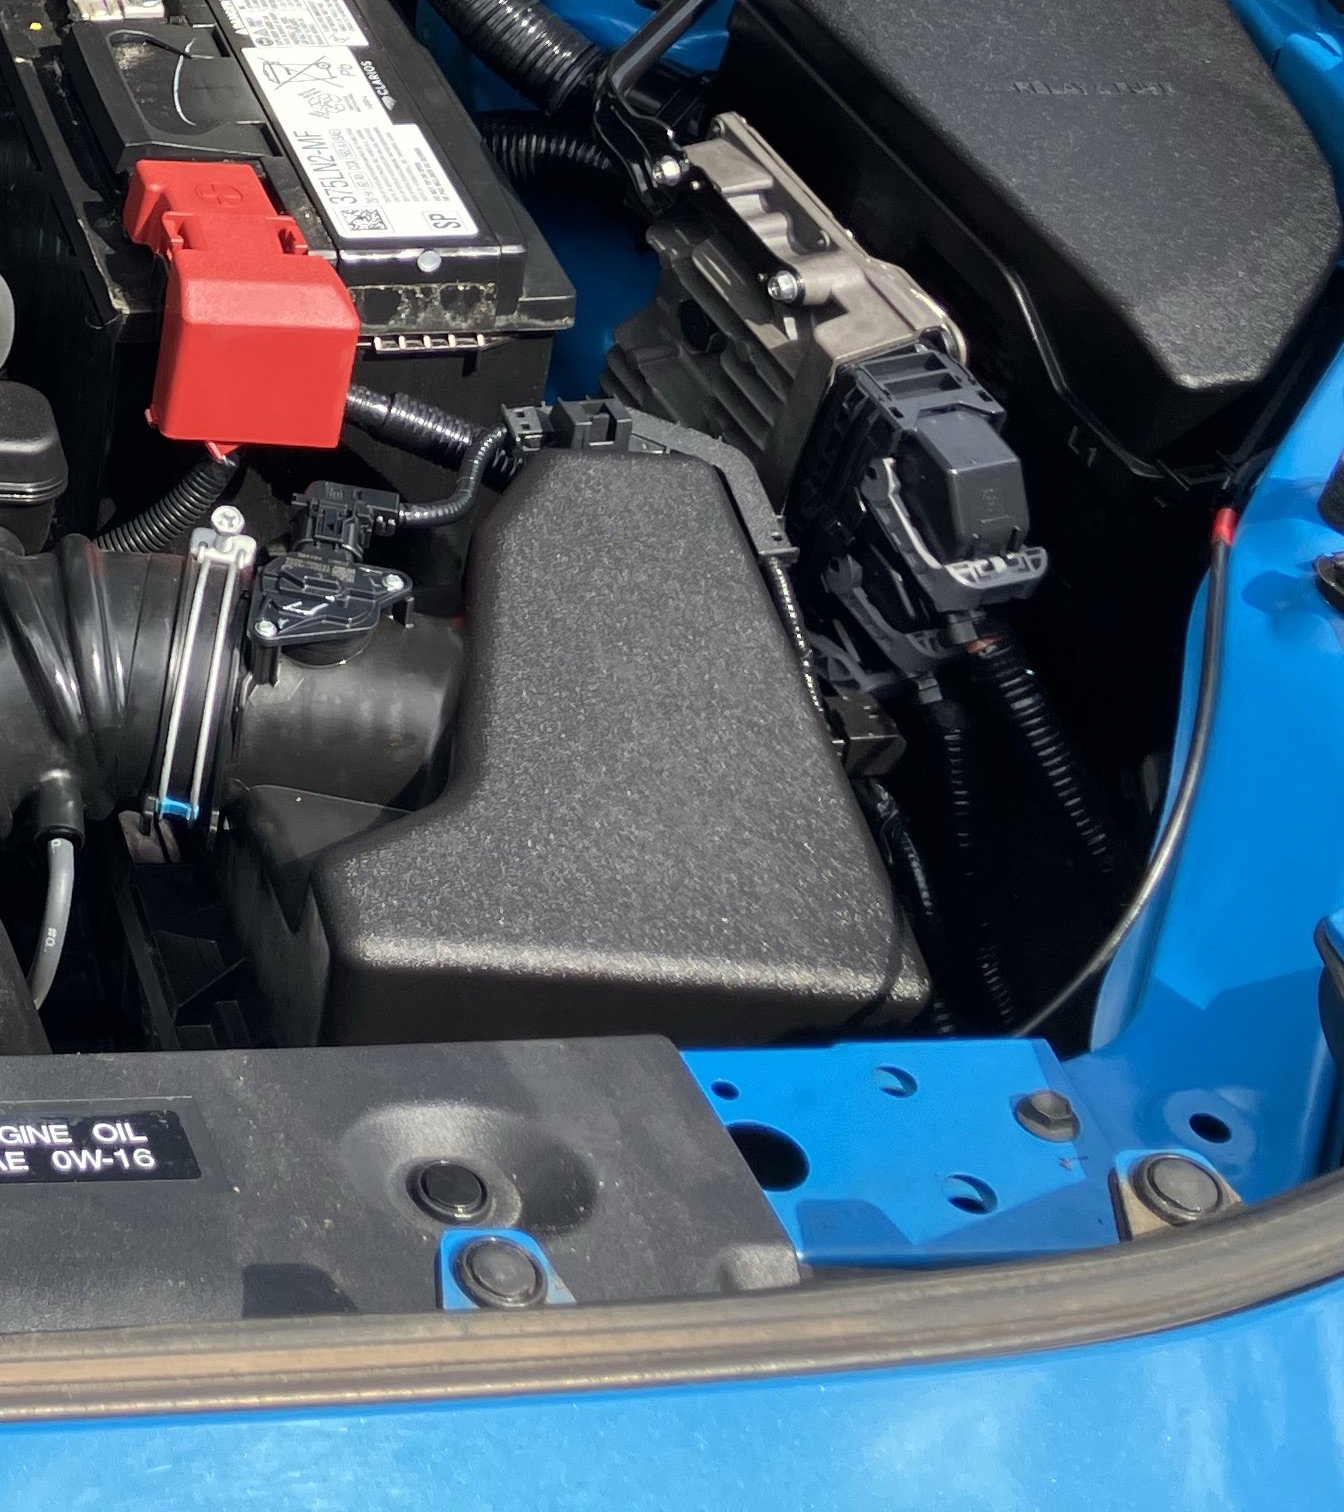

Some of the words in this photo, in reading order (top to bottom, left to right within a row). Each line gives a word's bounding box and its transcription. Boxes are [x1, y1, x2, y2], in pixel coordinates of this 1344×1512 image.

[334, 62, 358, 77] Pb
[357, 59, 392, 96] CLARIOS
[291, 129, 359, 206] 375LN2-MF
[425, 211, 463, 229] SP
[1066, 425, 1099, 468] L1
[92, 1121, 148, 1144] OIL
[52, 1148, 156, 1173] 0W-16
